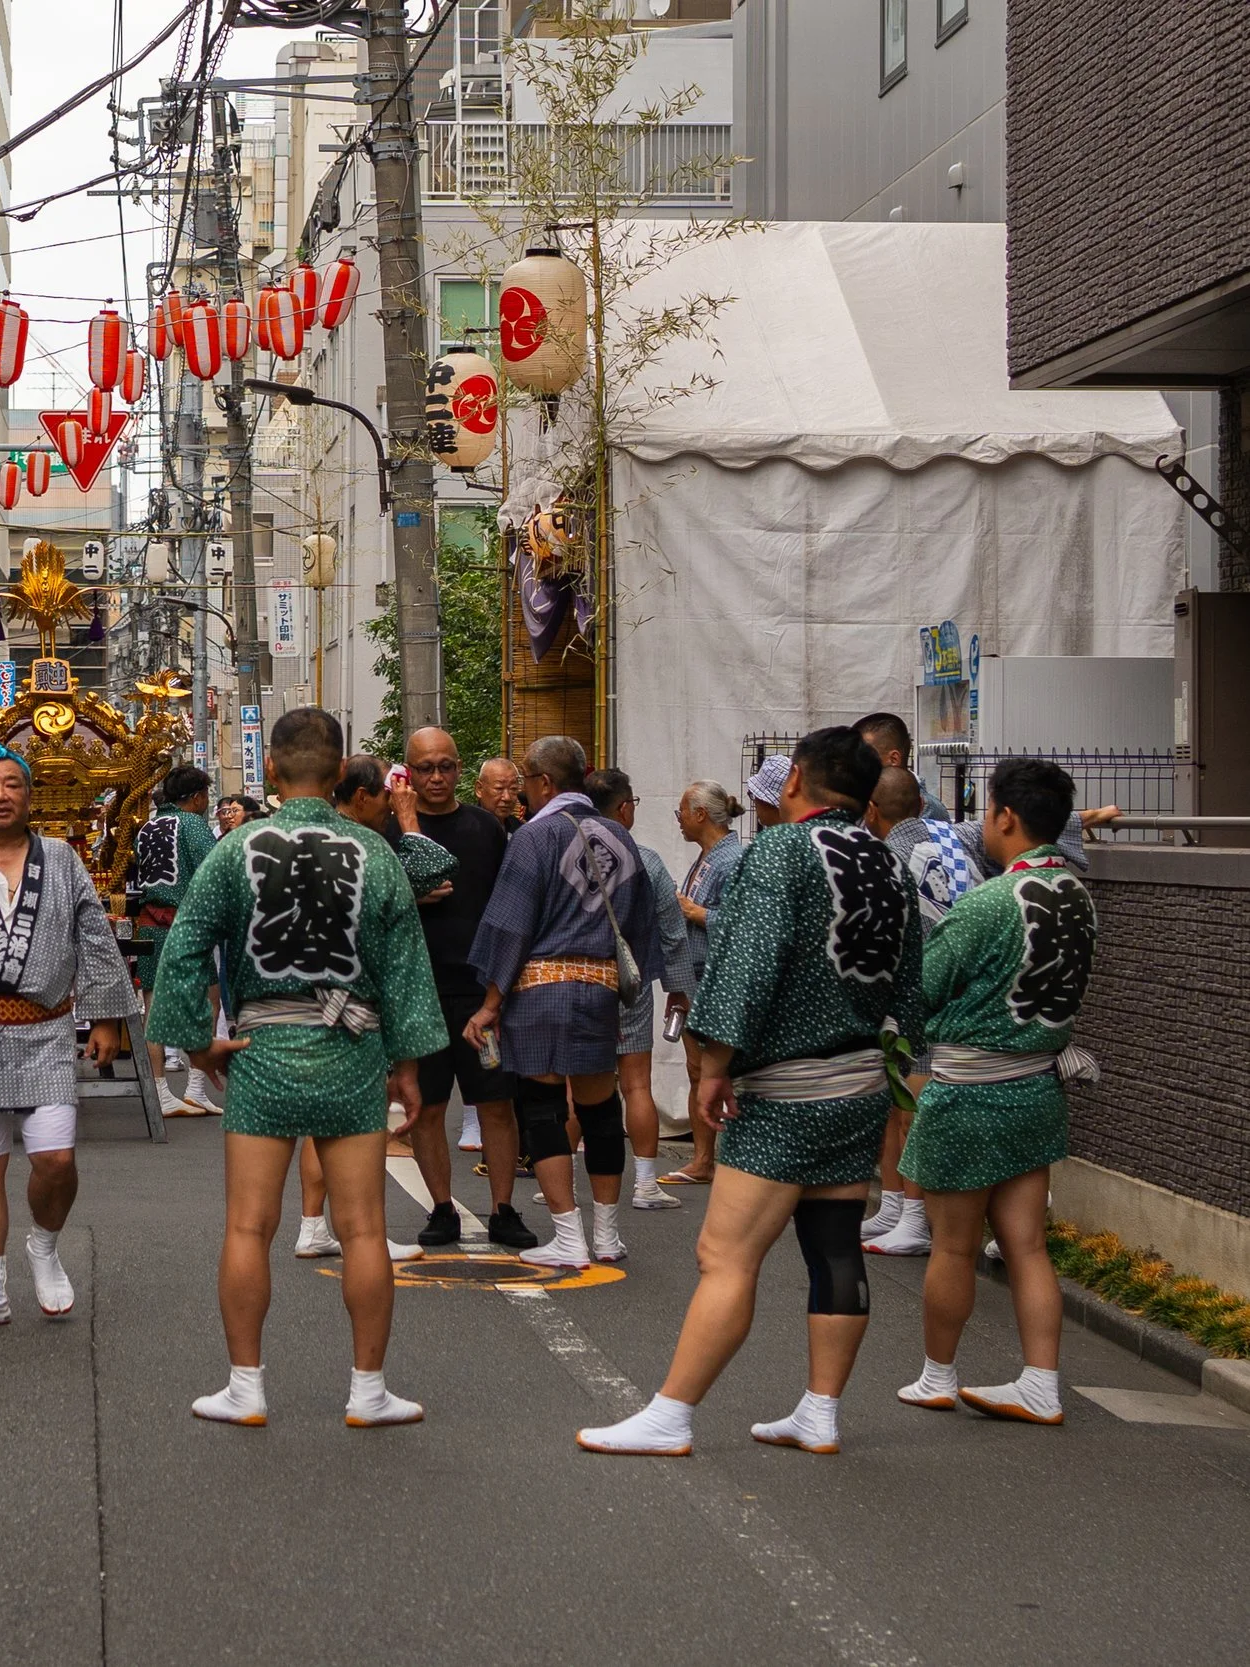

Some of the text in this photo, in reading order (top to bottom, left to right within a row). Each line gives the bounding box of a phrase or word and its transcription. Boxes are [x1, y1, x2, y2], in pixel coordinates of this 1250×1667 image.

[84, 542, 99, 573] 中二
[211, 547, 226, 577] 中二
[278, 593, 290, 641] サミット印刷
[244, 732, 255, 783] 清水薬局
